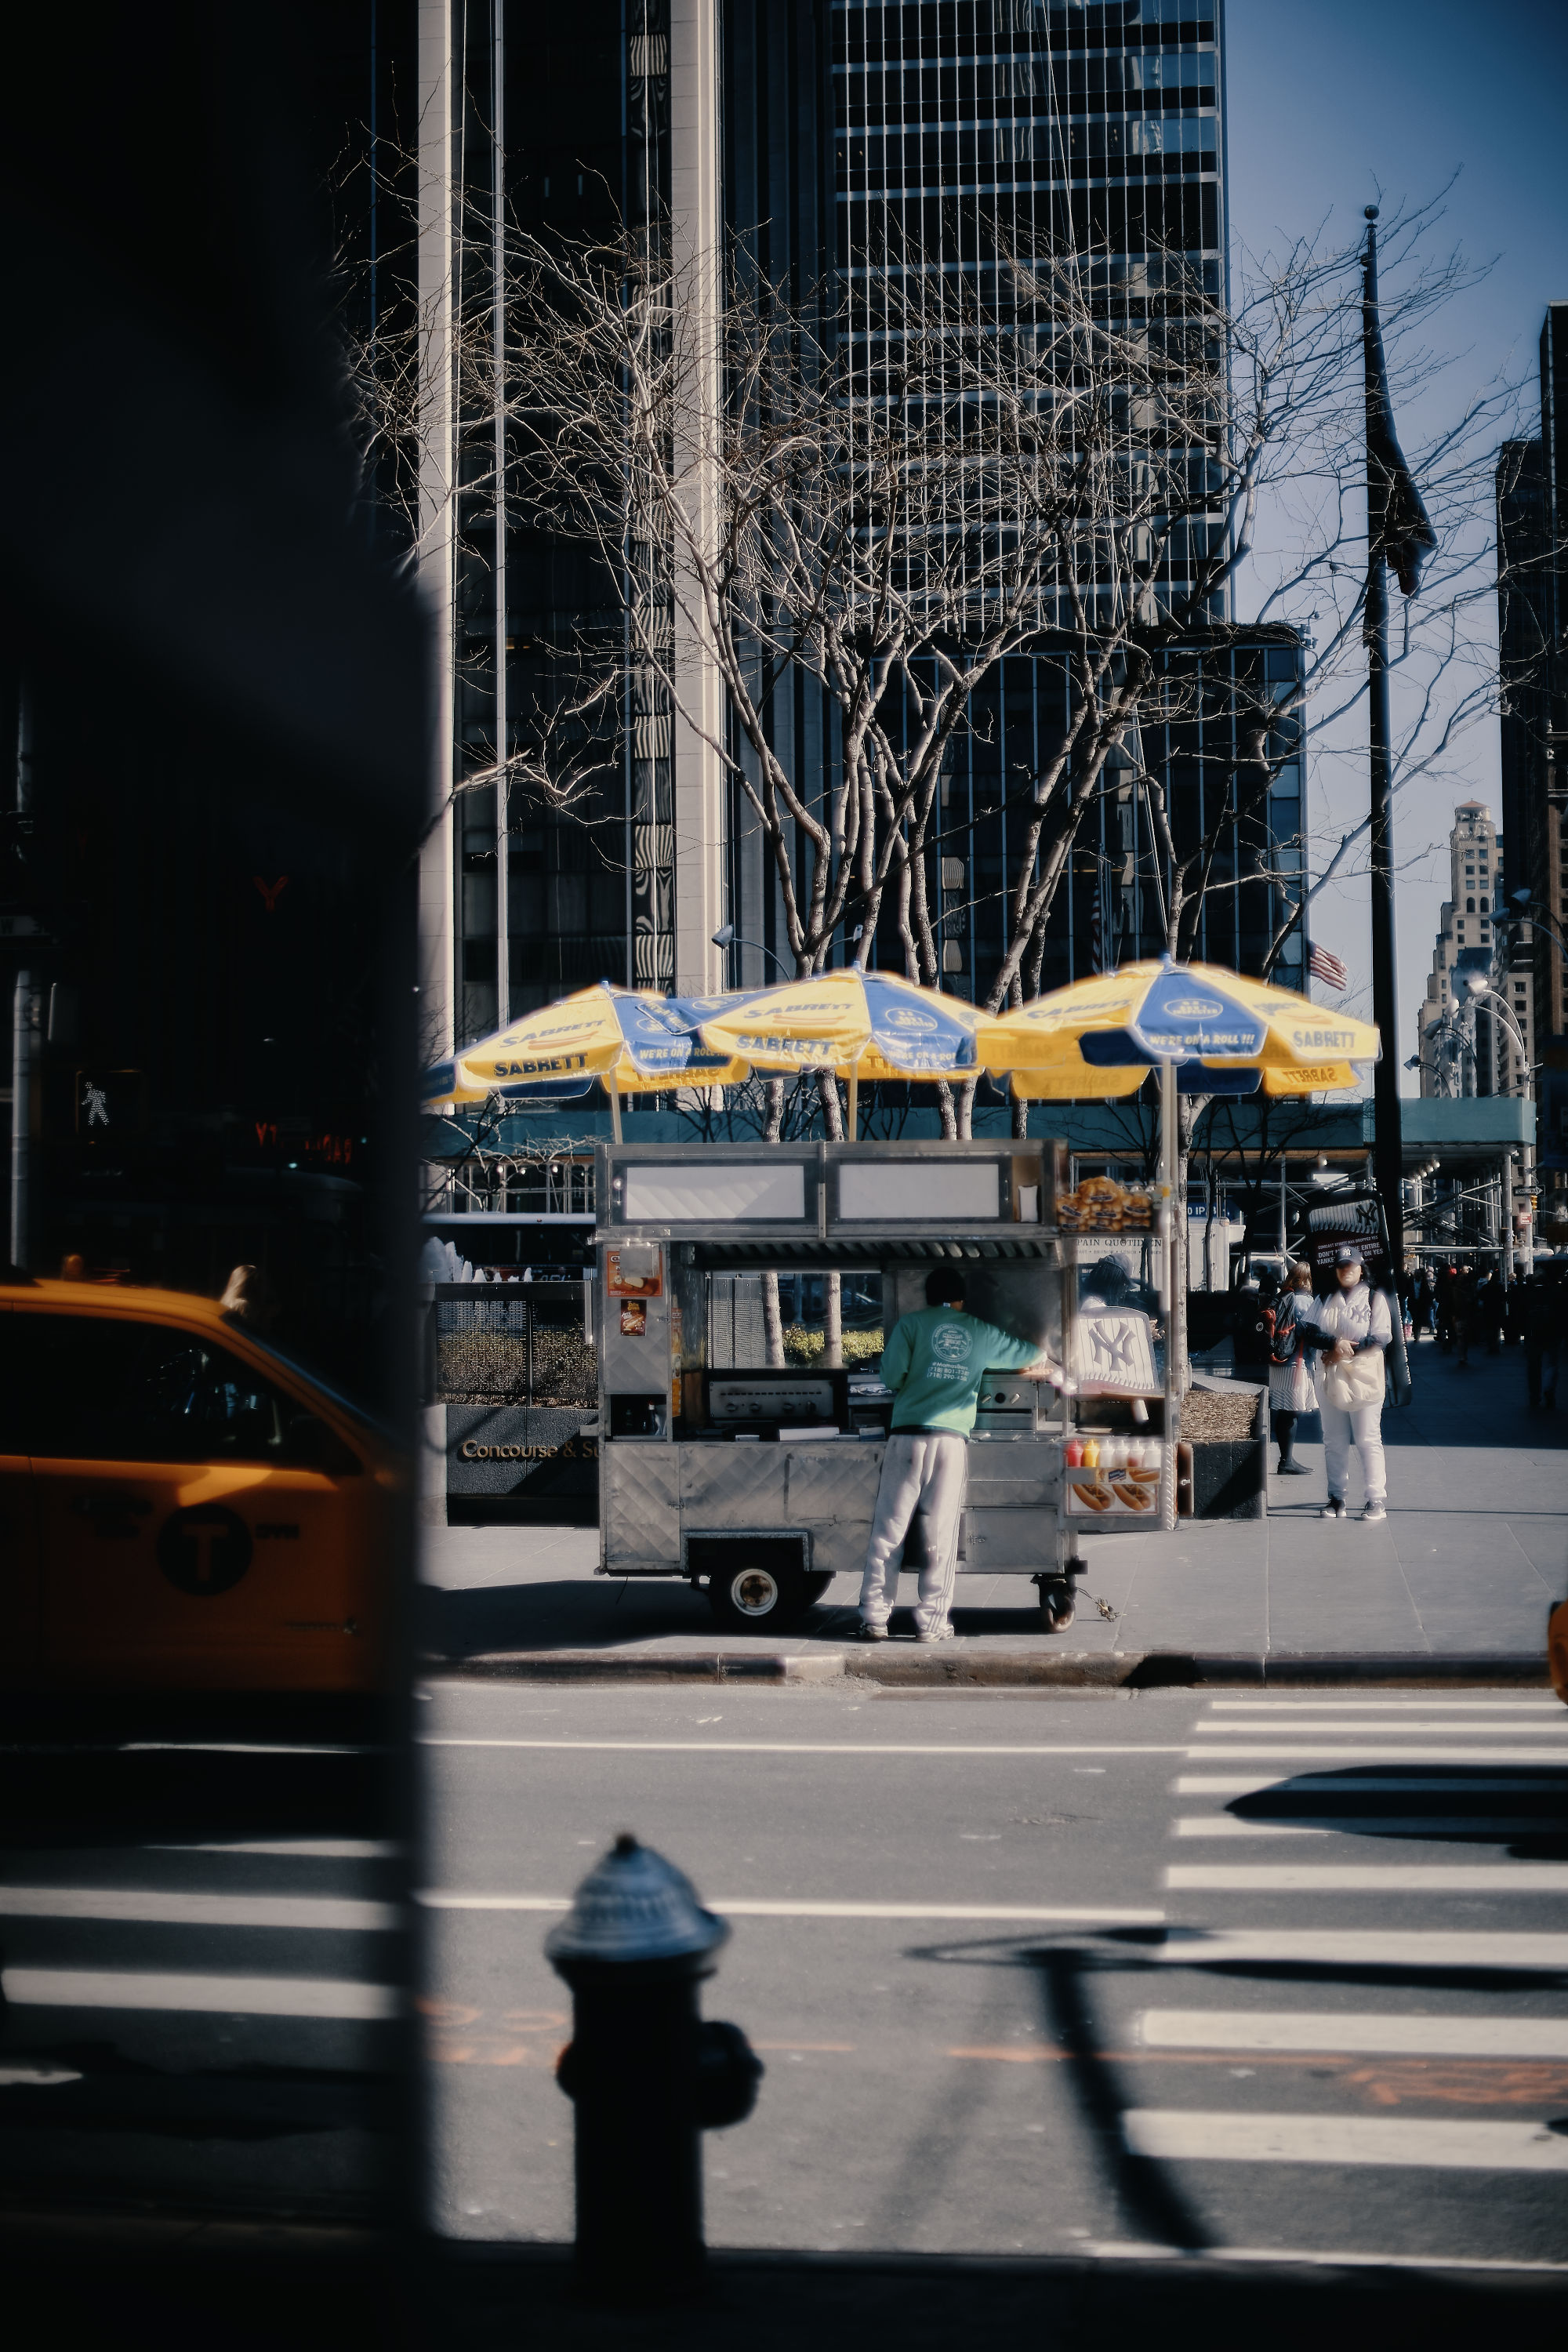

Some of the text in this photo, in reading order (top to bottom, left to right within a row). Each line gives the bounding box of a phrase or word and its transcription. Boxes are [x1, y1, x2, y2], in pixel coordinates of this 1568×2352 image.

[743, 1004, 855, 1019] SABRETT
[499, 1019, 607, 1048] SABRETT
[1149, 1033, 1256, 1046] WE'RE ON A ROLL !!!
[1293, 1030, 1356, 1048] SABRETT
[736, 1033, 836, 1055] SABRETT
[639, 1047, 669, 1060] WE'RE
[671, 1047, 684, 1058] ON
[684, 1047, 693, 1058] A
[494, 1052, 589, 1077] SABRETT
[1361, 1243, 1381, 1251] ENTIRE
[1316, 1256, 1336, 1265] YANKE
[462, 1439, 558, 1459] Concourse
[563, 1440, 577, 1458] &
